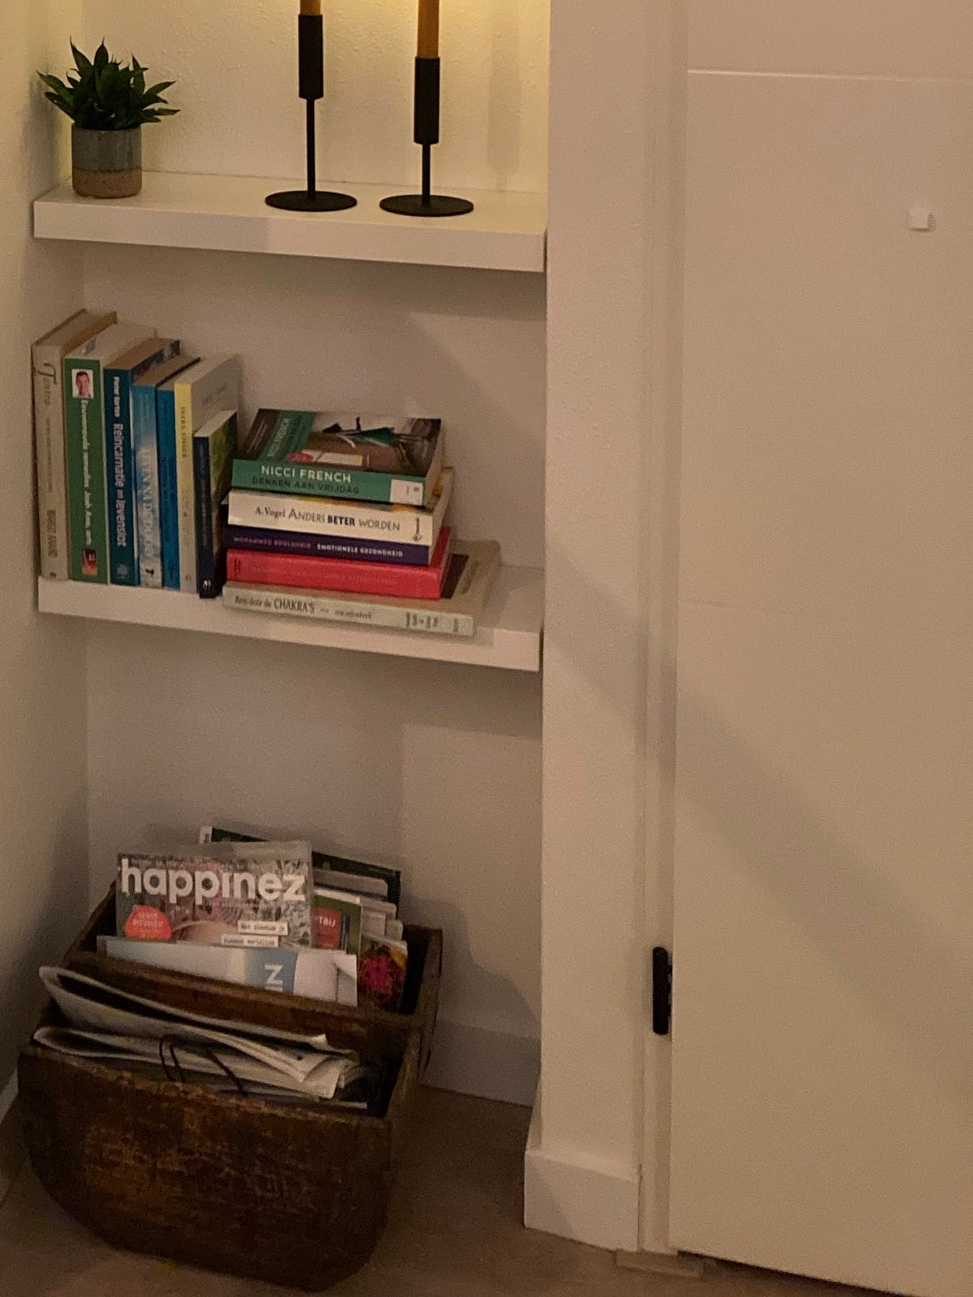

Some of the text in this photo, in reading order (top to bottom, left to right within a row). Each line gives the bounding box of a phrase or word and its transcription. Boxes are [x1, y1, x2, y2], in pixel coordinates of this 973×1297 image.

[261, 465, 351, 484] NICCI FRENCH
[116, 489, 124, 499] en
[252, 476, 360, 495] DENKEN AAN VRIJDAG
[114, 499, 128, 547] levenslot
[254, 506, 401, 532] A. Vogel ANDERS BETER WORDEN
[316, 543, 358, 554] EMOTIONELE
[360, 547, 404, 558] GEZONDHEID
[273, 597, 315, 613] CHAKRA'S
[121, 857, 306, 906] happinez
